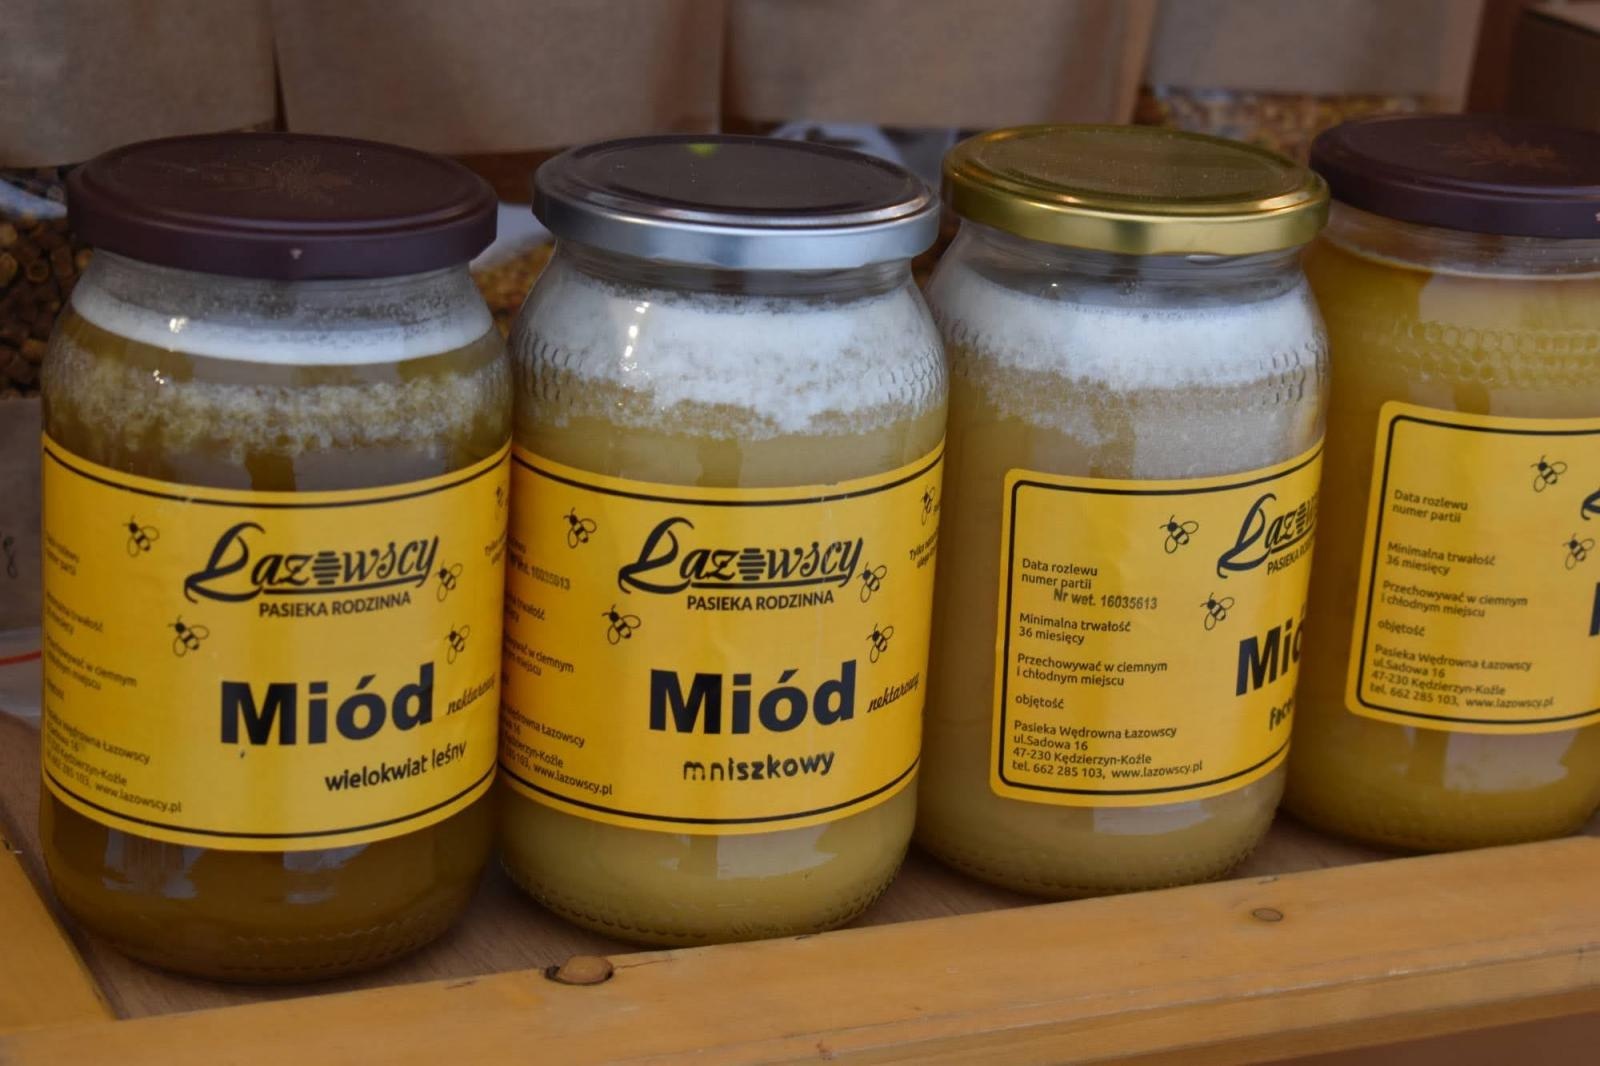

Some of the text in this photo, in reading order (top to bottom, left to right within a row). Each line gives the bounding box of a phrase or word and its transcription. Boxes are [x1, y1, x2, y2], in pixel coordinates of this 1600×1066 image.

[1393, 489, 1469, 511] Data rozlewu
[1392, 503, 1462, 523] numer partii
[1388, 541, 1496, 566] Minimalna trwałość
[1022, 558, 1098, 577] Data rozlewu
[1386, 554, 1451, 576] 36 miesięcy
[1021, 573, 1092, 590] numer partii
[259, 591, 411, 618] PASIEKA RODZINNA
[687, 590, 834, 611] PASIEKA RODZINNA
[1053, 588, 1069, 601] Nr
[1100, 594, 1158, 610] 16035613
[1383, 580, 1528, 608] Przechowywać w ciemnym
[1387, 594, 1441, 613] chłodnym
[1443, 604, 1485, 619] miejscu
[1019, 612, 1131, 633] Minimalna trwałość
[1377, 619, 1425, 637] objętość
[1019, 627, 1085, 645] 36 miesięcy
[1017, 652, 1168, 674] Przechowywać w ciemnym
[1375, 644, 1532, 673] Pasieka Wędrowna Łazowscy
[1022, 669, 1078, 686] chłodnym
[1080, 675, 1125, 688] miejscu
[1371, 670, 1409, 686] 47-230
[1432, 667, 1446, 678] 16
[649, 659, 857, 735] Miód
[866, 672, 920, 713] nektarowy
[1015, 694, 1065, 710] objętość
[1370, 682, 1387, 695] tel.
[1390, 687, 1411, 699] 662
[1413, 690, 1434, 703] 285
[220, 661, 435, 746] Miód
[541, 723, 586, 749] Łazowscy
[1014, 719, 1178, 740] Pasieka Wędrowna Łazowscy
[1013, 735, 1089, 751] ul.Sadowa 16
[683, 751, 835, 781] mniszkowy
[1012, 746, 1152, 767] 47-230 Kędzierzyn-Koźle
[325, 755, 427, 792] wielokwiat
[1012, 759, 1203, 780] tel. 662 285 103, www.lazowscy.pl
